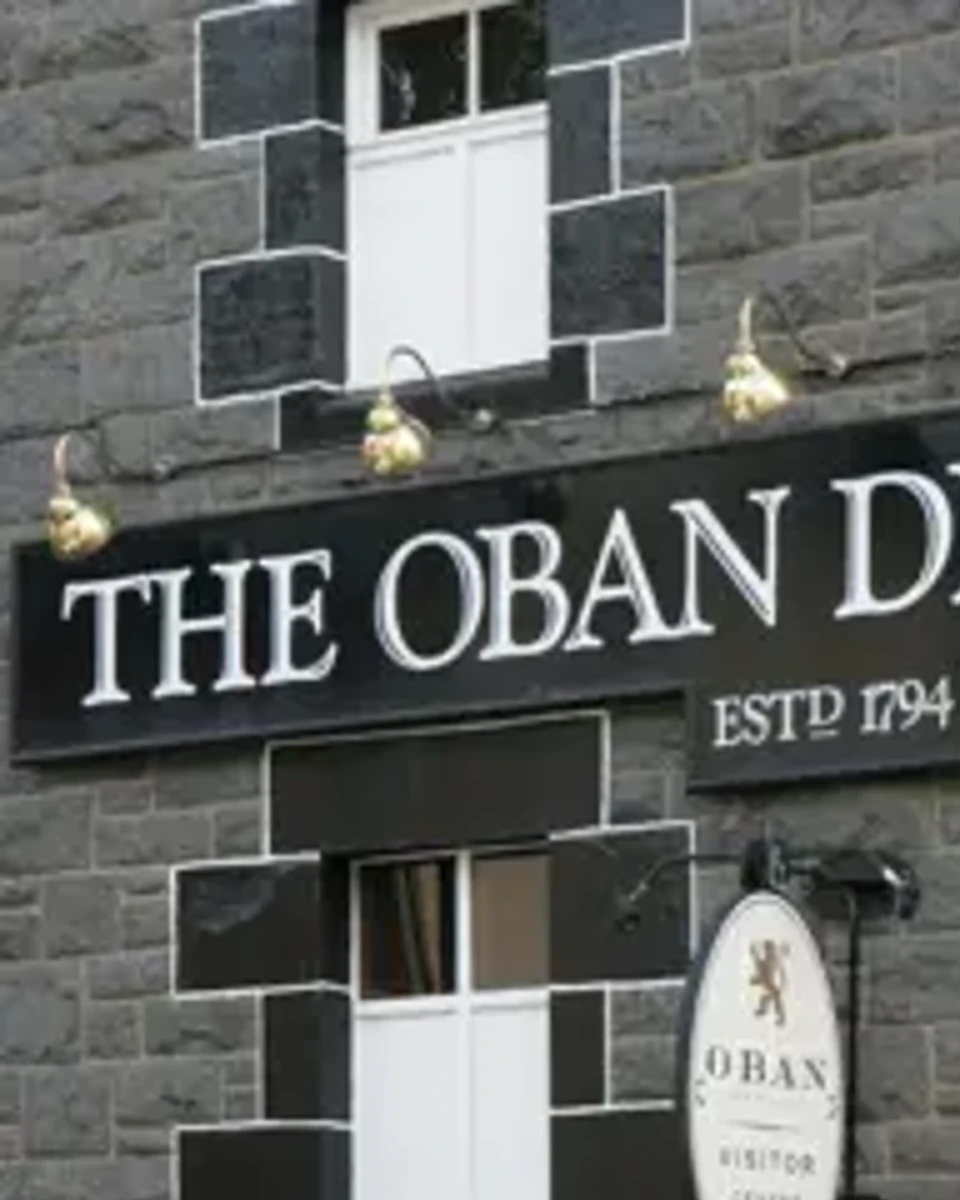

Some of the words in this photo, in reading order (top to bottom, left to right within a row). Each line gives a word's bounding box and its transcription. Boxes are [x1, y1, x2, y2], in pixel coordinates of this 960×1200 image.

[60, 549, 338, 707] THE
[374, 485, 789, 671] OBAN
[711, 685, 847, 747] ESTD
[860, 674, 954, 735] 1794
[704, 1045, 828, 1091] OBAN
[719, 1148, 817, 1176] VISITOR
